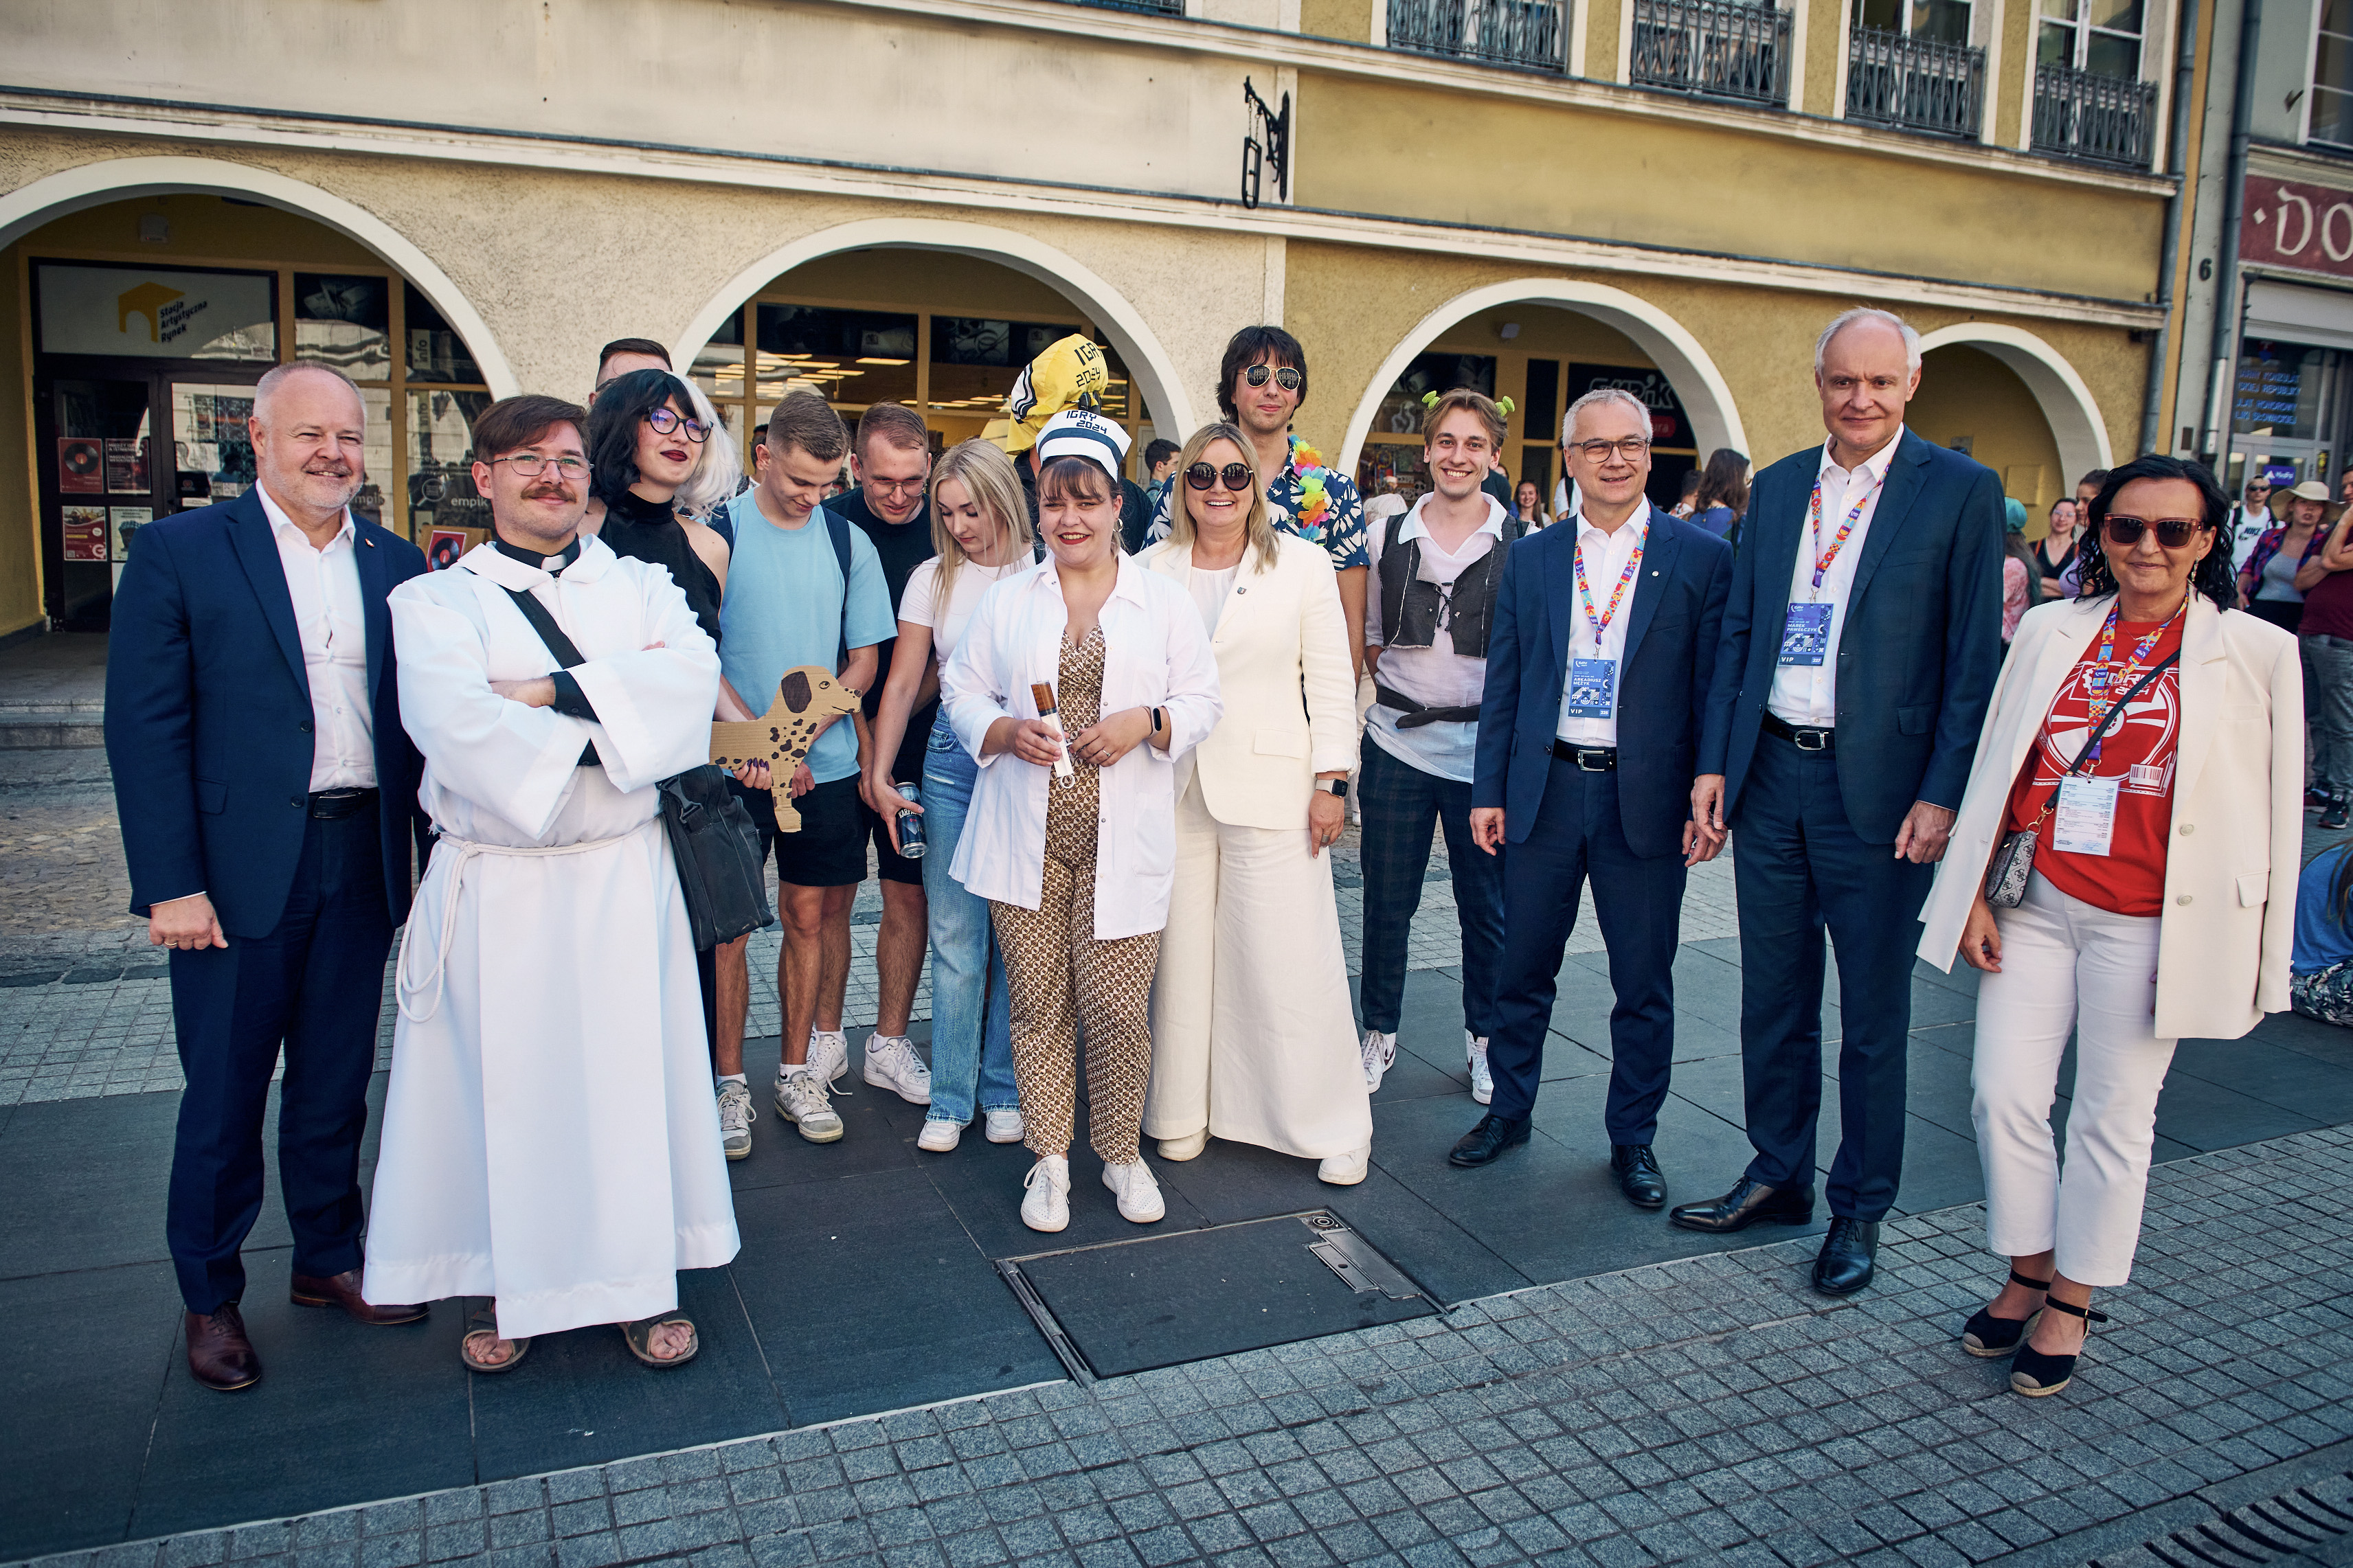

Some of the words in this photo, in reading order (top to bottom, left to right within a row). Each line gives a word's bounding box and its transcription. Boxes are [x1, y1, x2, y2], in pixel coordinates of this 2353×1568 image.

[2200, 258, 2213, 282] 6
[160, 301, 183, 318] Stacja
[161, 301, 207, 330] Artystyczna
[161, 323, 186, 343] Rynek
[414, 339, 427, 363] info
[1076, 367, 1101, 388] 2024
[1066, 410, 1097, 421] IGRY
[1076, 420, 1107, 434] 2024
[354, 492, 385, 505] mpik
[451, 495, 488, 509] empik
[2244, 525, 2262, 536] NIKE
